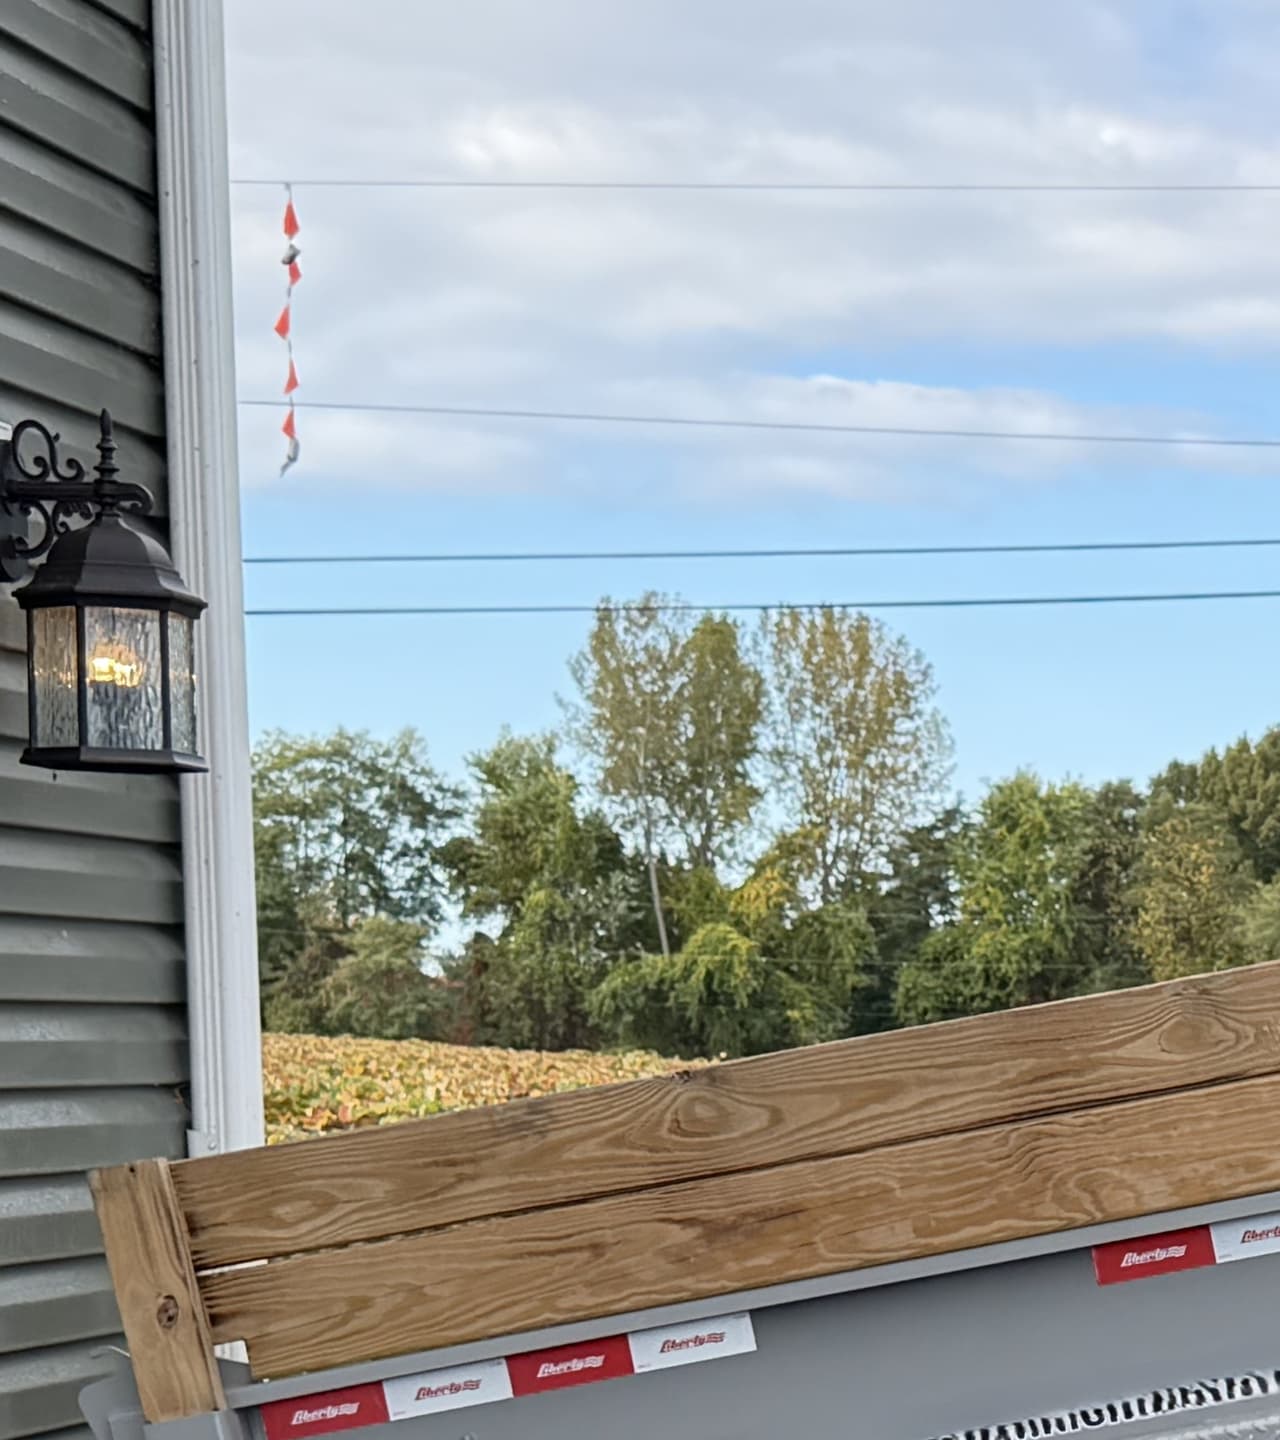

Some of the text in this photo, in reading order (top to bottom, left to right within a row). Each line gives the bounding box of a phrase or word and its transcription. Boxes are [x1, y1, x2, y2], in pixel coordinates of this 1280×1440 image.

[1120, 1247, 1169, 1267] Liberty
[659, 1335, 708, 1354] Liberty
[536, 1358, 585, 1378] Liberty
[414, 1382, 463, 1401] Liberty
[291, 1404, 341, 1425] Liberty
